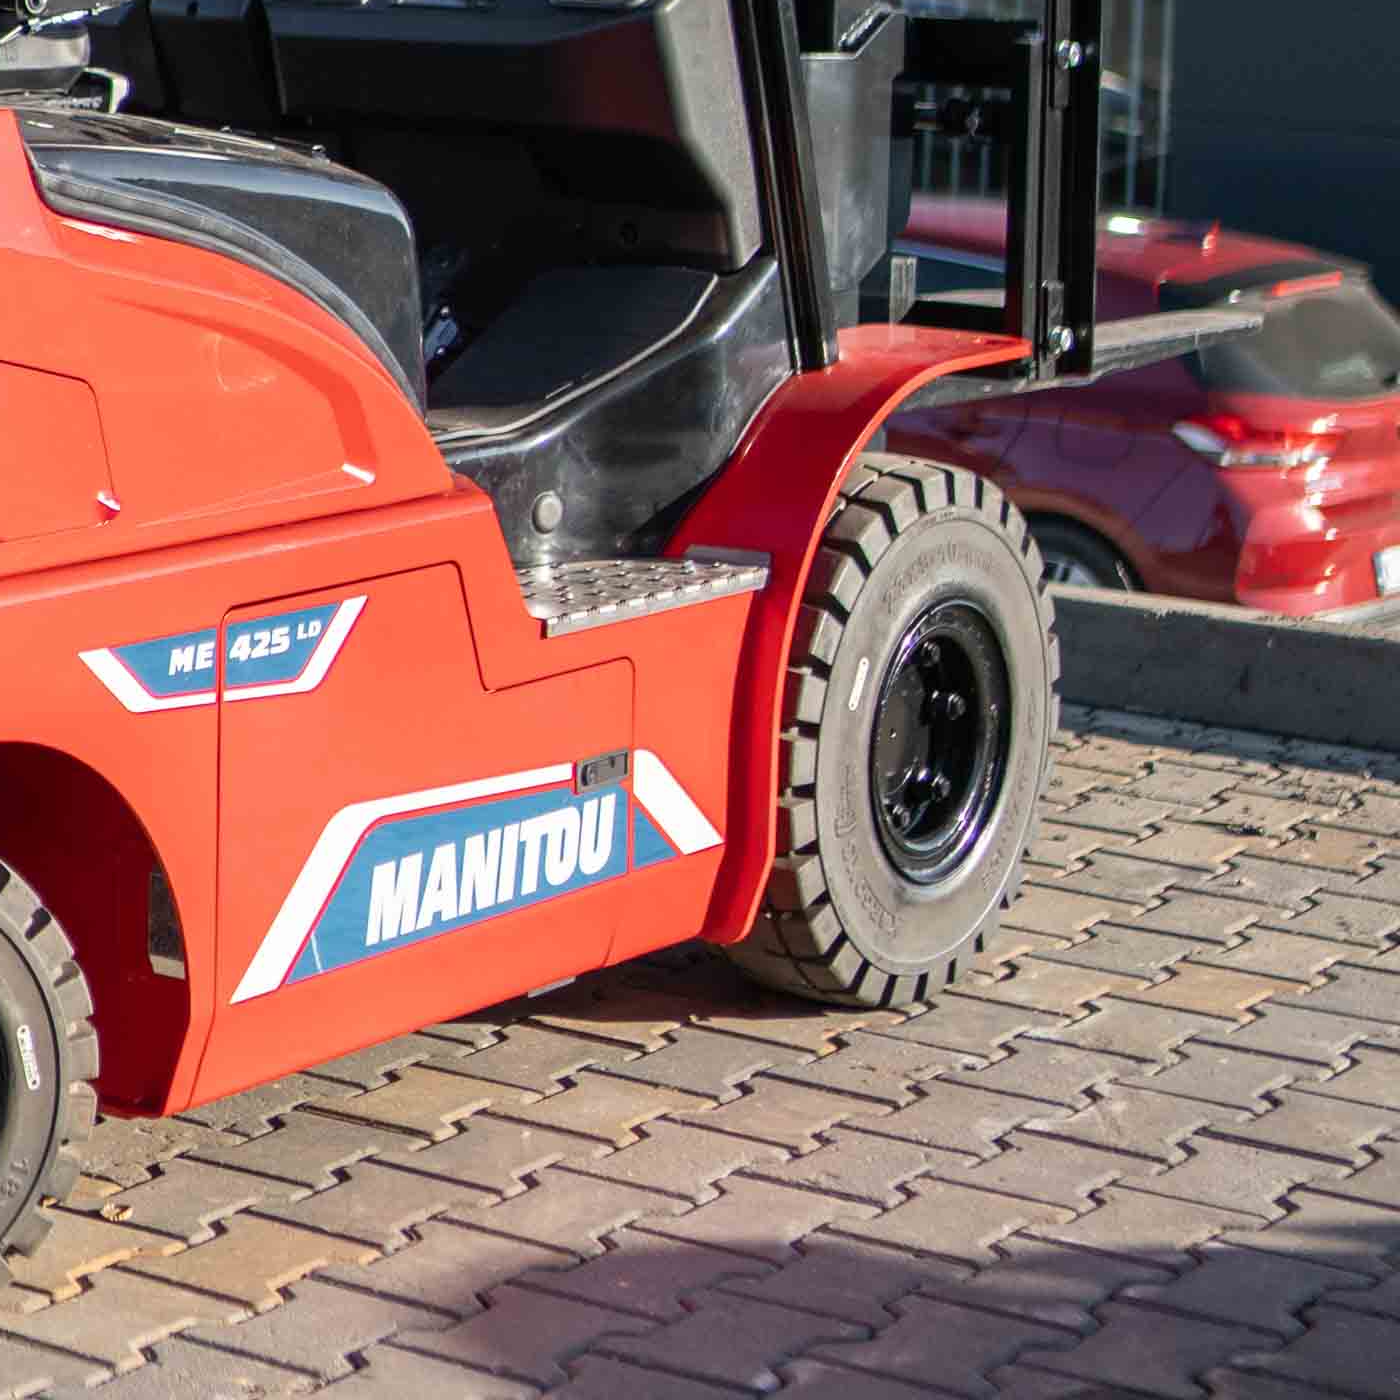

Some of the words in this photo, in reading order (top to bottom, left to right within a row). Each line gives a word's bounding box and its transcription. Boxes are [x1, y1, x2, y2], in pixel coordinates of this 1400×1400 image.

[168, 641, 216, 676] ME
[229, 626, 290, 663] 425
[296, 620, 322, 640] LD
[365, 793, 617, 947] MANITOU
